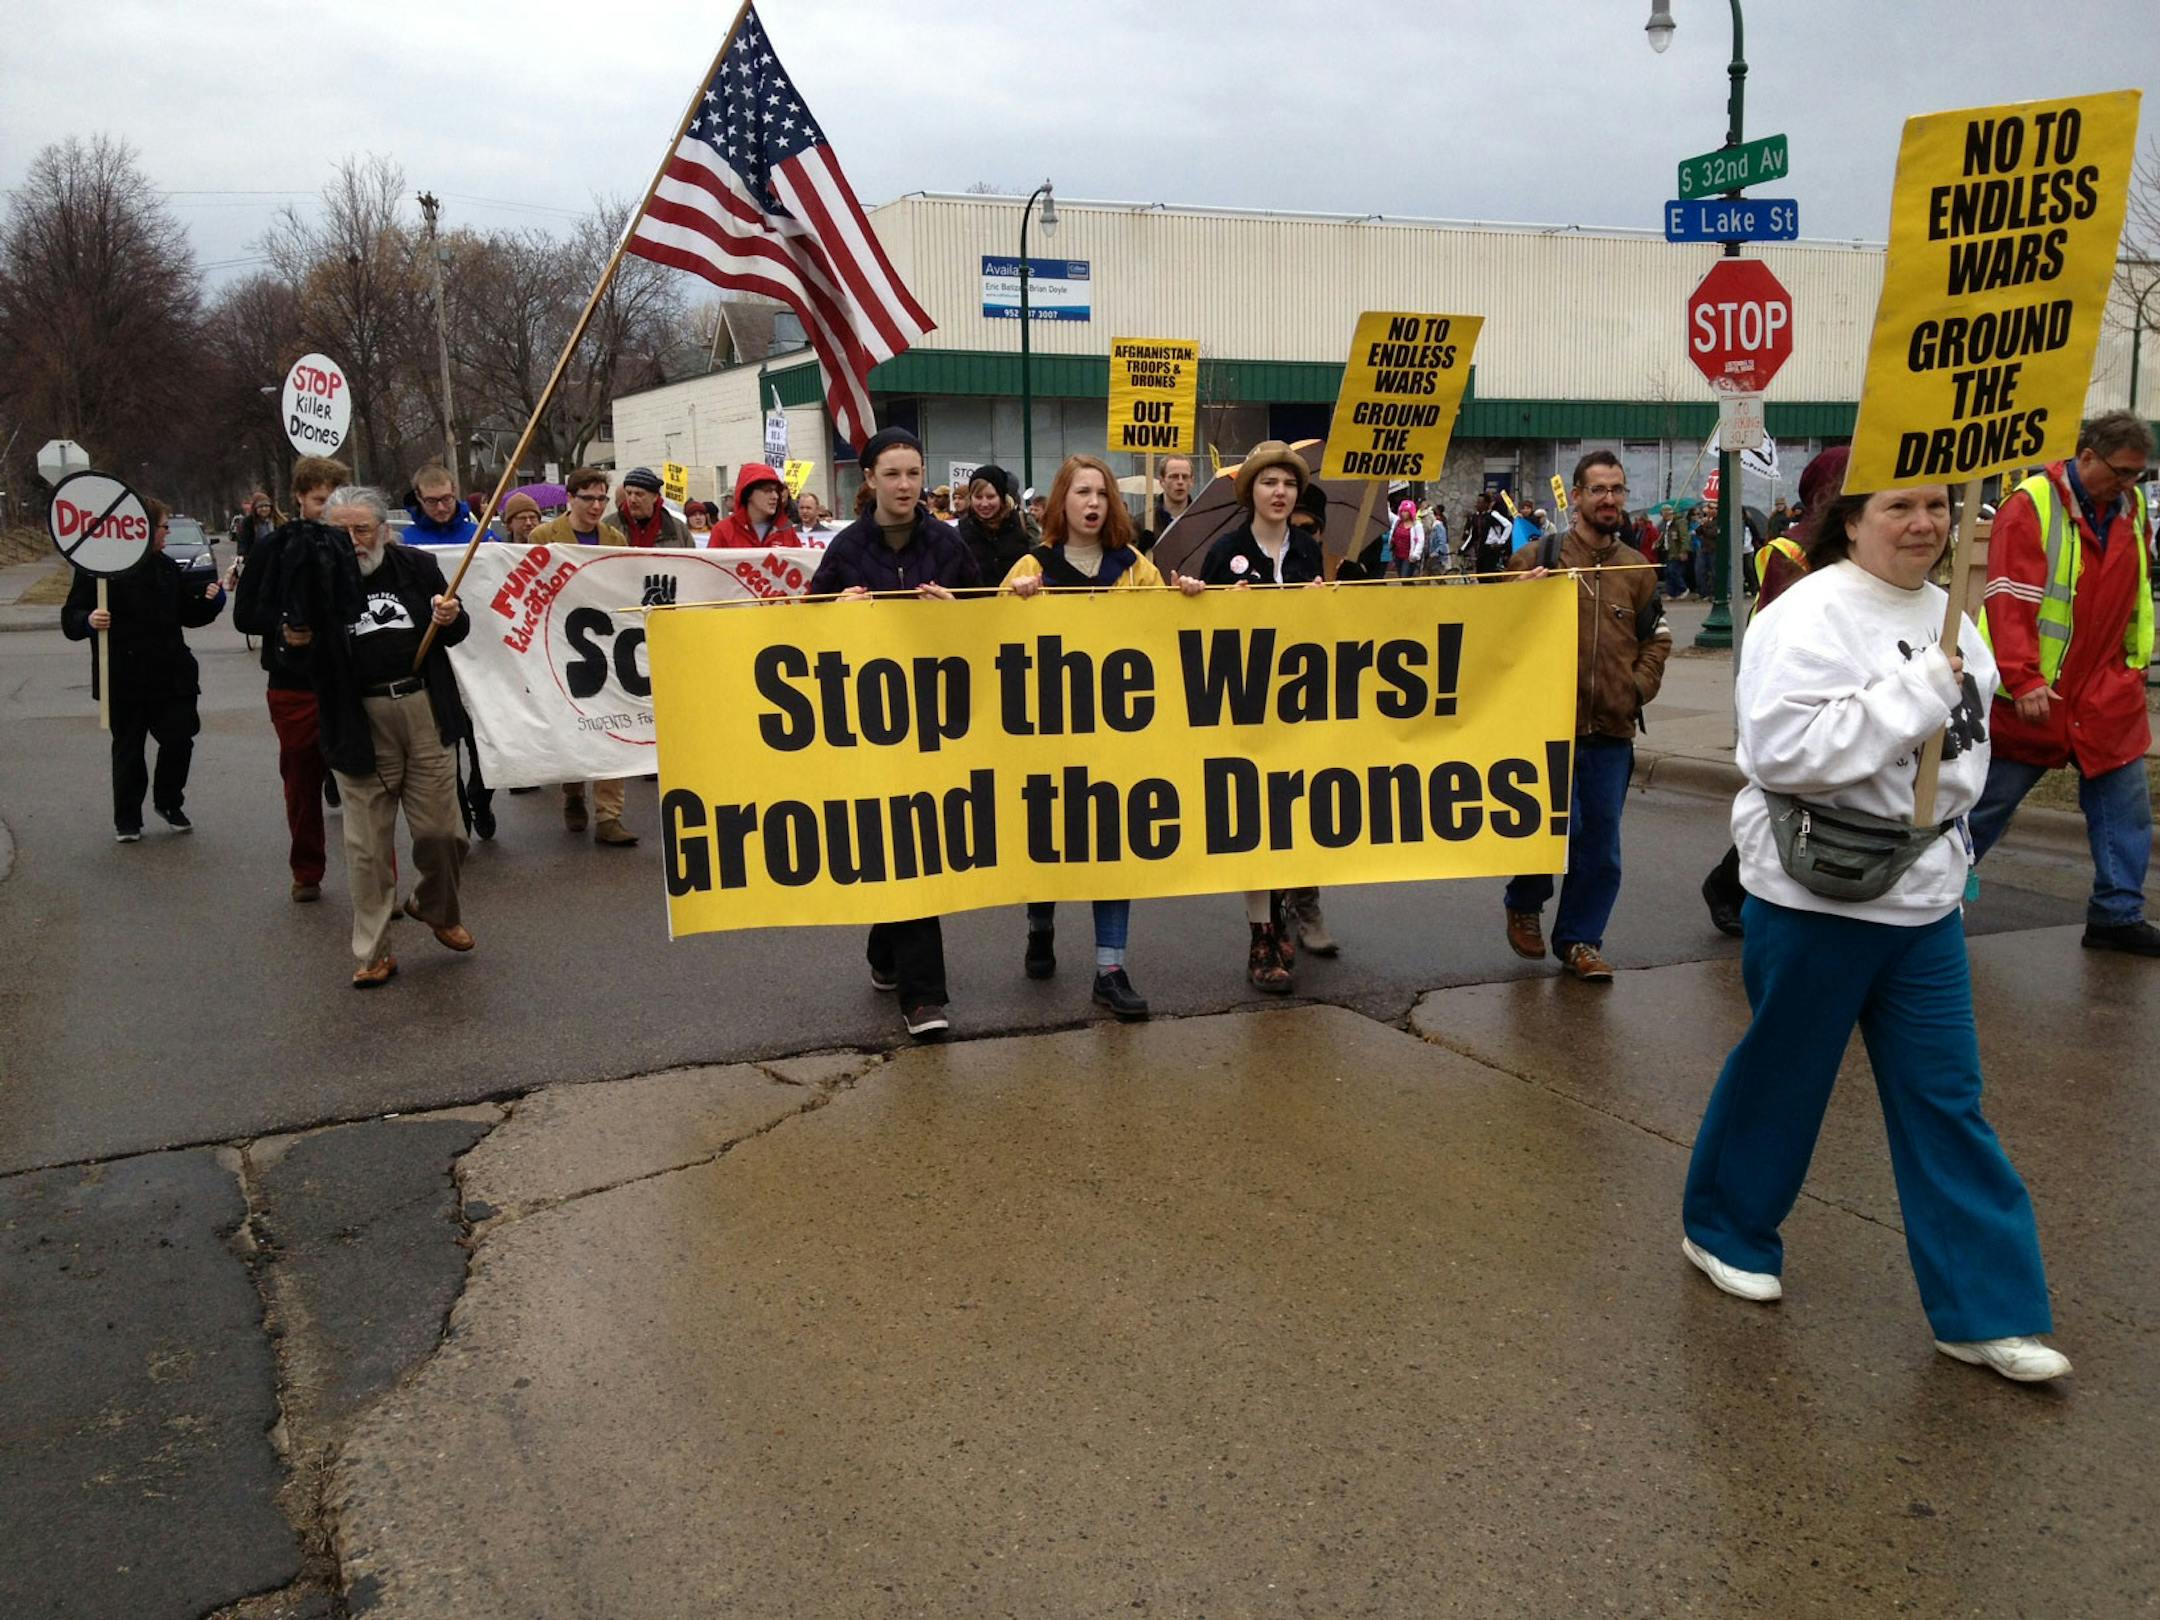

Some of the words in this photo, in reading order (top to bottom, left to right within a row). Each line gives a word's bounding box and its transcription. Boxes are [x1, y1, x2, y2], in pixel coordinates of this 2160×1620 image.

[1962, 117, 2024, 177] NO
[2034, 108, 2081, 167] TO
[1682, 167, 1693, 193] S
[1702, 153, 1749, 187] 32nd
[1759, 146, 1784, 173] Av
[1928, 165, 2099, 241] ENDLESS
[1670, 207, 1685, 234] E
[1701, 207, 1755, 233] Lake
[1769, 206, 1794, 232] St
[985, 262, 1036, 277] Availae
[1947, 228, 2068, 296] WARS
[1388, 317, 1420, 342] NO
[1424, 318, 1450, 343] TO
[1694, 301, 1788, 353] STOP
[1907, 299, 2073, 372] GROUND
[1114, 345, 1195, 361] AFGHANISTAN:
[1126, 360, 1171, 374] TROOPS
[1173, 364, 1181, 375] &
[1367, 343, 1457, 369] ENDLESS
[293, 364, 342, 399] STOP
[1131, 374, 1176, 388] DRONES
[1374, 370, 1438, 395] WARS
[1952, 362, 2022, 420] THE
[1133, 401, 1174, 424] OUT
[1353, 402, 1440, 427] GROUND
[290, 415, 340, 447] Drones
[1123, 425, 1179, 448] NOW!
[1371, 428, 1410, 451] THE
[1894, 407, 2048, 479] DRONES
[953, 467, 976, 478] STO
[1342, 451, 1425, 476] DRONES
[56, 499, 147, 540] Drones
[490, 545, 551, 620] FUND
[503, 561, 579, 654] Education
[754, 644, 971, 752] Stop
[995, 635, 1155, 735] the
[1178, 623, 1464, 727] Wars!
[662, 769, 998, 897] Ground
[1021, 766, 1181, 862] the
[1204, 740, 1570, 855] Drones!
